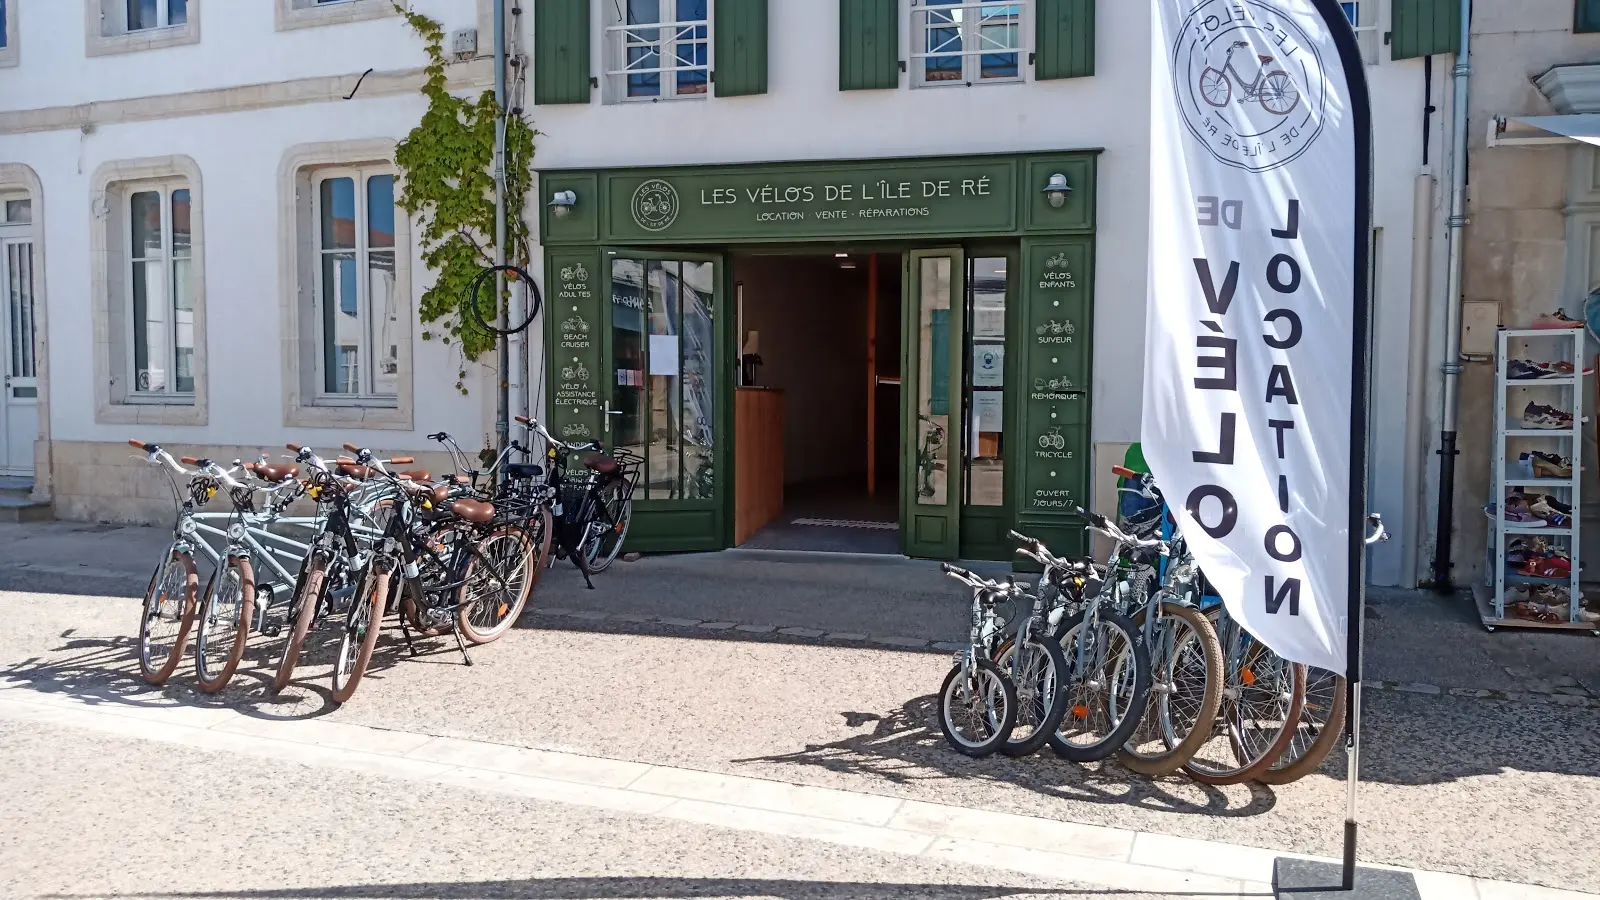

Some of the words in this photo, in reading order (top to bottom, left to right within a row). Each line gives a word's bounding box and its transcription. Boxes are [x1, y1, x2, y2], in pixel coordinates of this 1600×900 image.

[701, 188, 737, 205] LES
[746, 184, 814, 203] VÉLOS
[824, 184, 853, 201] DE
[862, 180, 911, 200] L'ÎLE
[921, 180, 951, 197] DE
[960, 175, 990, 196] RÉ
[756, 211, 804, 221] LOCATION
[815, 210, 847, 219] VENTE
[859, 207, 930, 218] RÉPARATIONS
[1043, 272, 1072, 280] VÉLOS
[563, 282, 587, 290] VÉLOS
[1039, 281, 1076, 289] ENFANTS
[1038, 336, 1073, 344] SUIVEUR
[1031, 392, 1078, 400] REMORQUE
[555, 398, 597, 406] ÉLECTRIQUE
[565, 468, 588, 476] VÉLOS
[1035, 489, 1070, 497] OUVERT
[1032, 499, 1074, 507] 7JOURS/7
